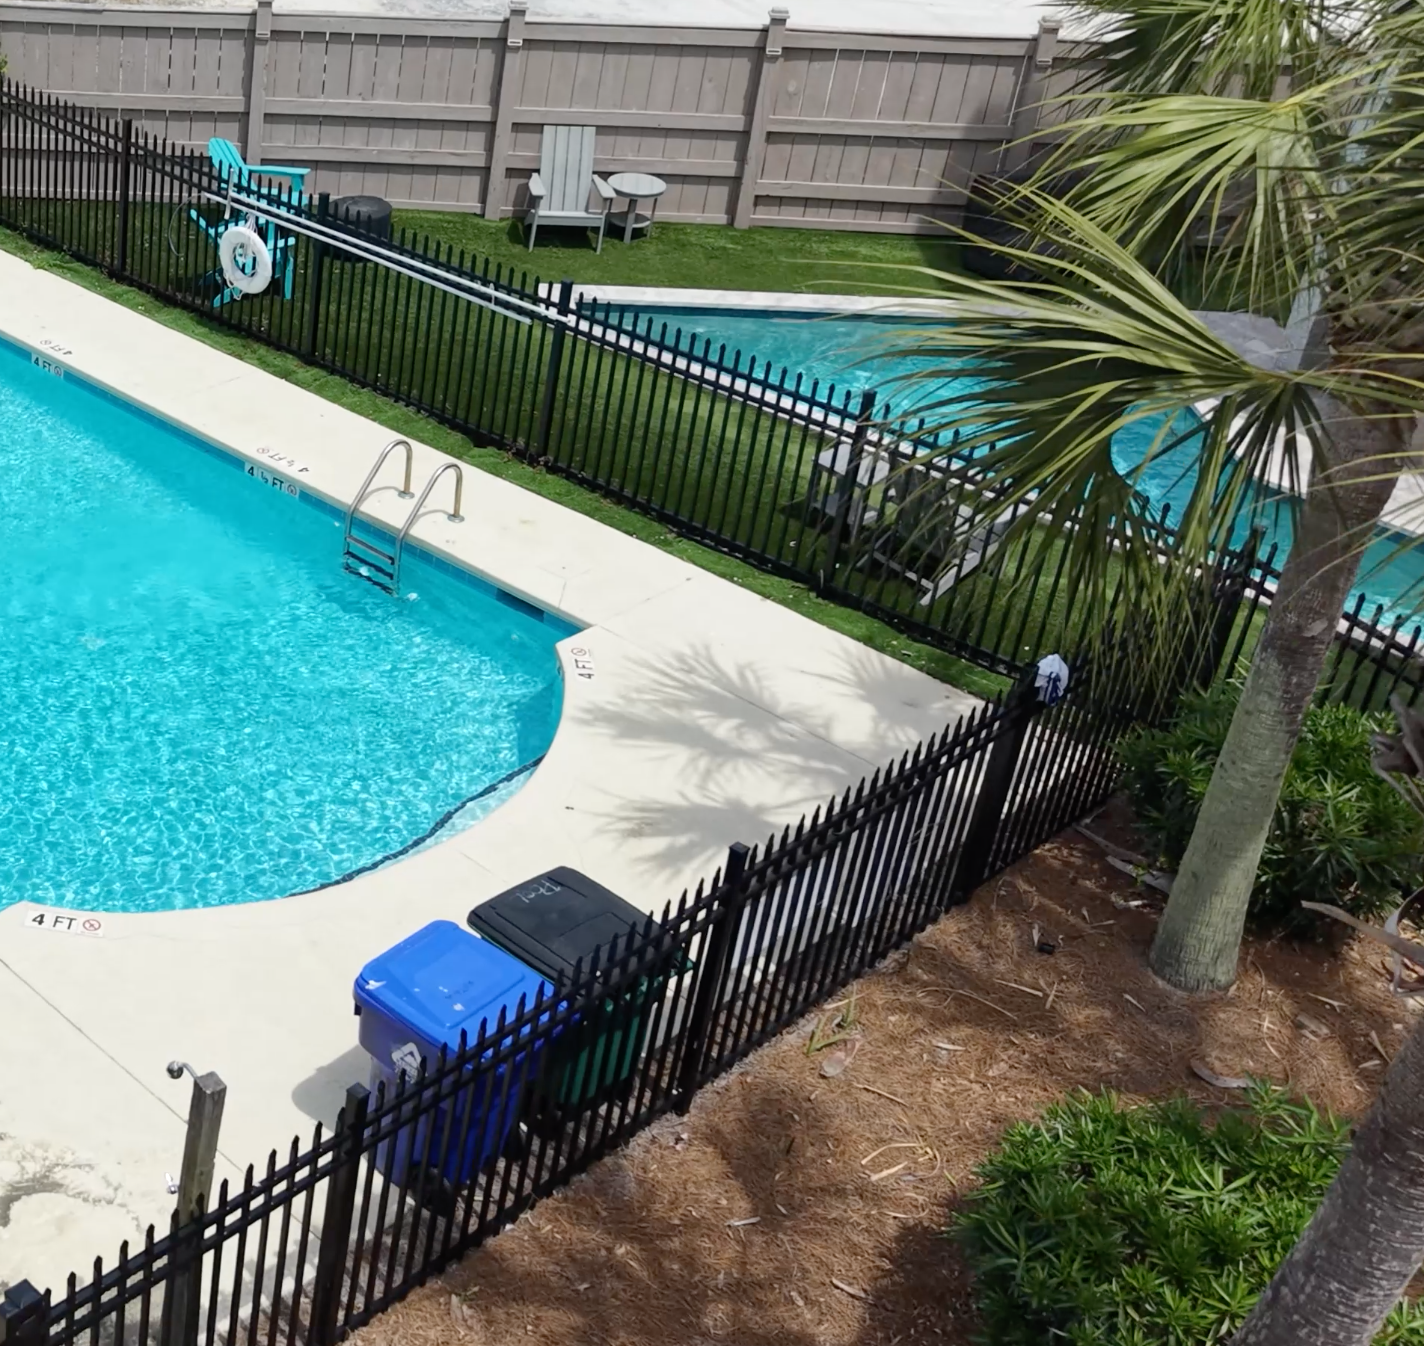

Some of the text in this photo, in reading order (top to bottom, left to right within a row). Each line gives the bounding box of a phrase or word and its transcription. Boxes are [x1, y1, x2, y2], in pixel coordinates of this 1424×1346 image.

[34, 356, 51, 373] 4 FT
[247, 466, 254, 477] 4
[272, 477, 284, 490] FT
[574, 658, 593, 670] FT
[32, 913, 77, 930] 4 FT
